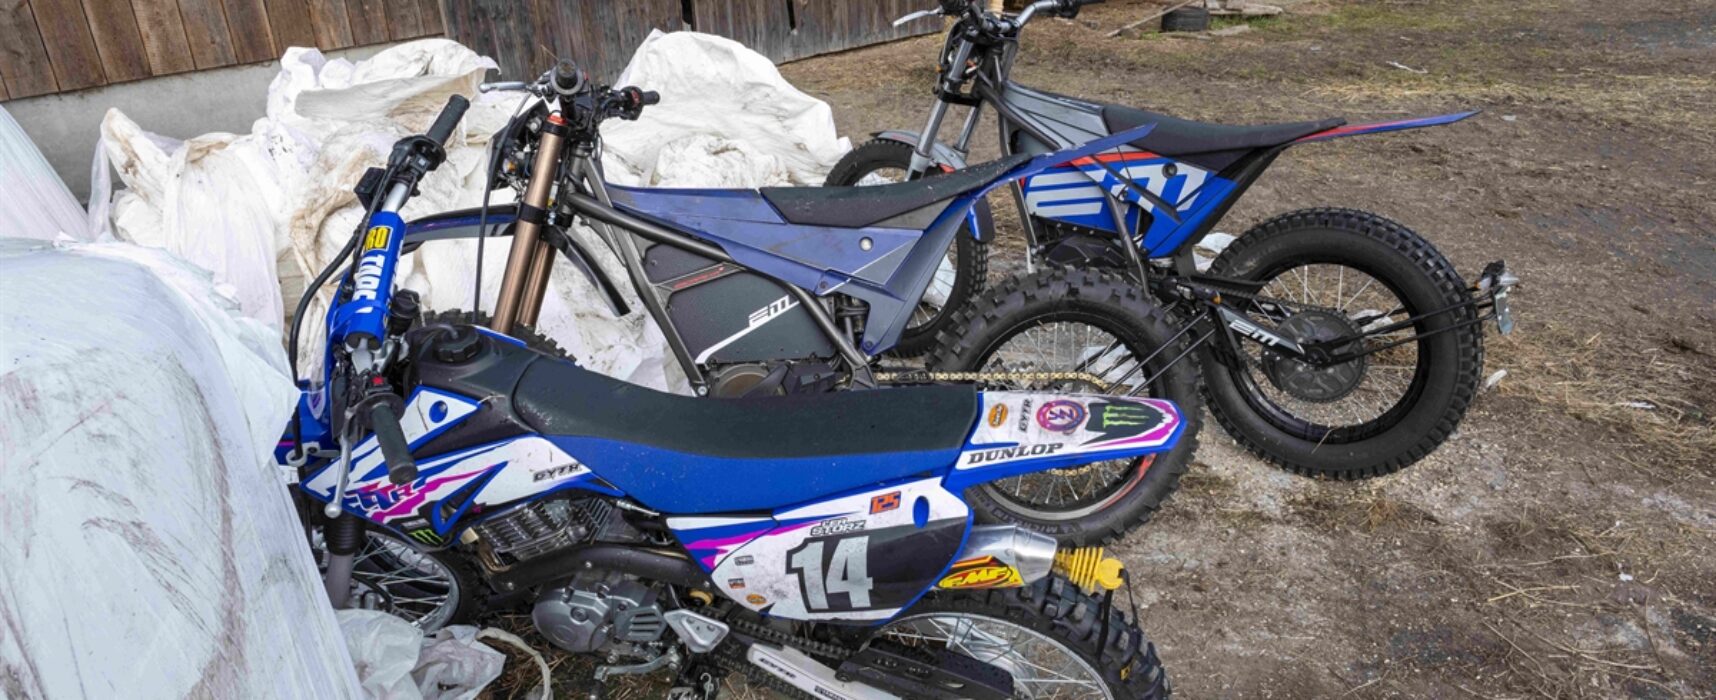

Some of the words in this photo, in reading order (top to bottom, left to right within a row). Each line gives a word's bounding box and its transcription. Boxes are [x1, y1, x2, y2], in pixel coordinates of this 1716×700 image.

[1018, 398, 1032, 432] GYTR
[967, 442, 1064, 465] DUNLOP
[869, 491, 901, 514] 125
[791, 536, 873, 610] 14
